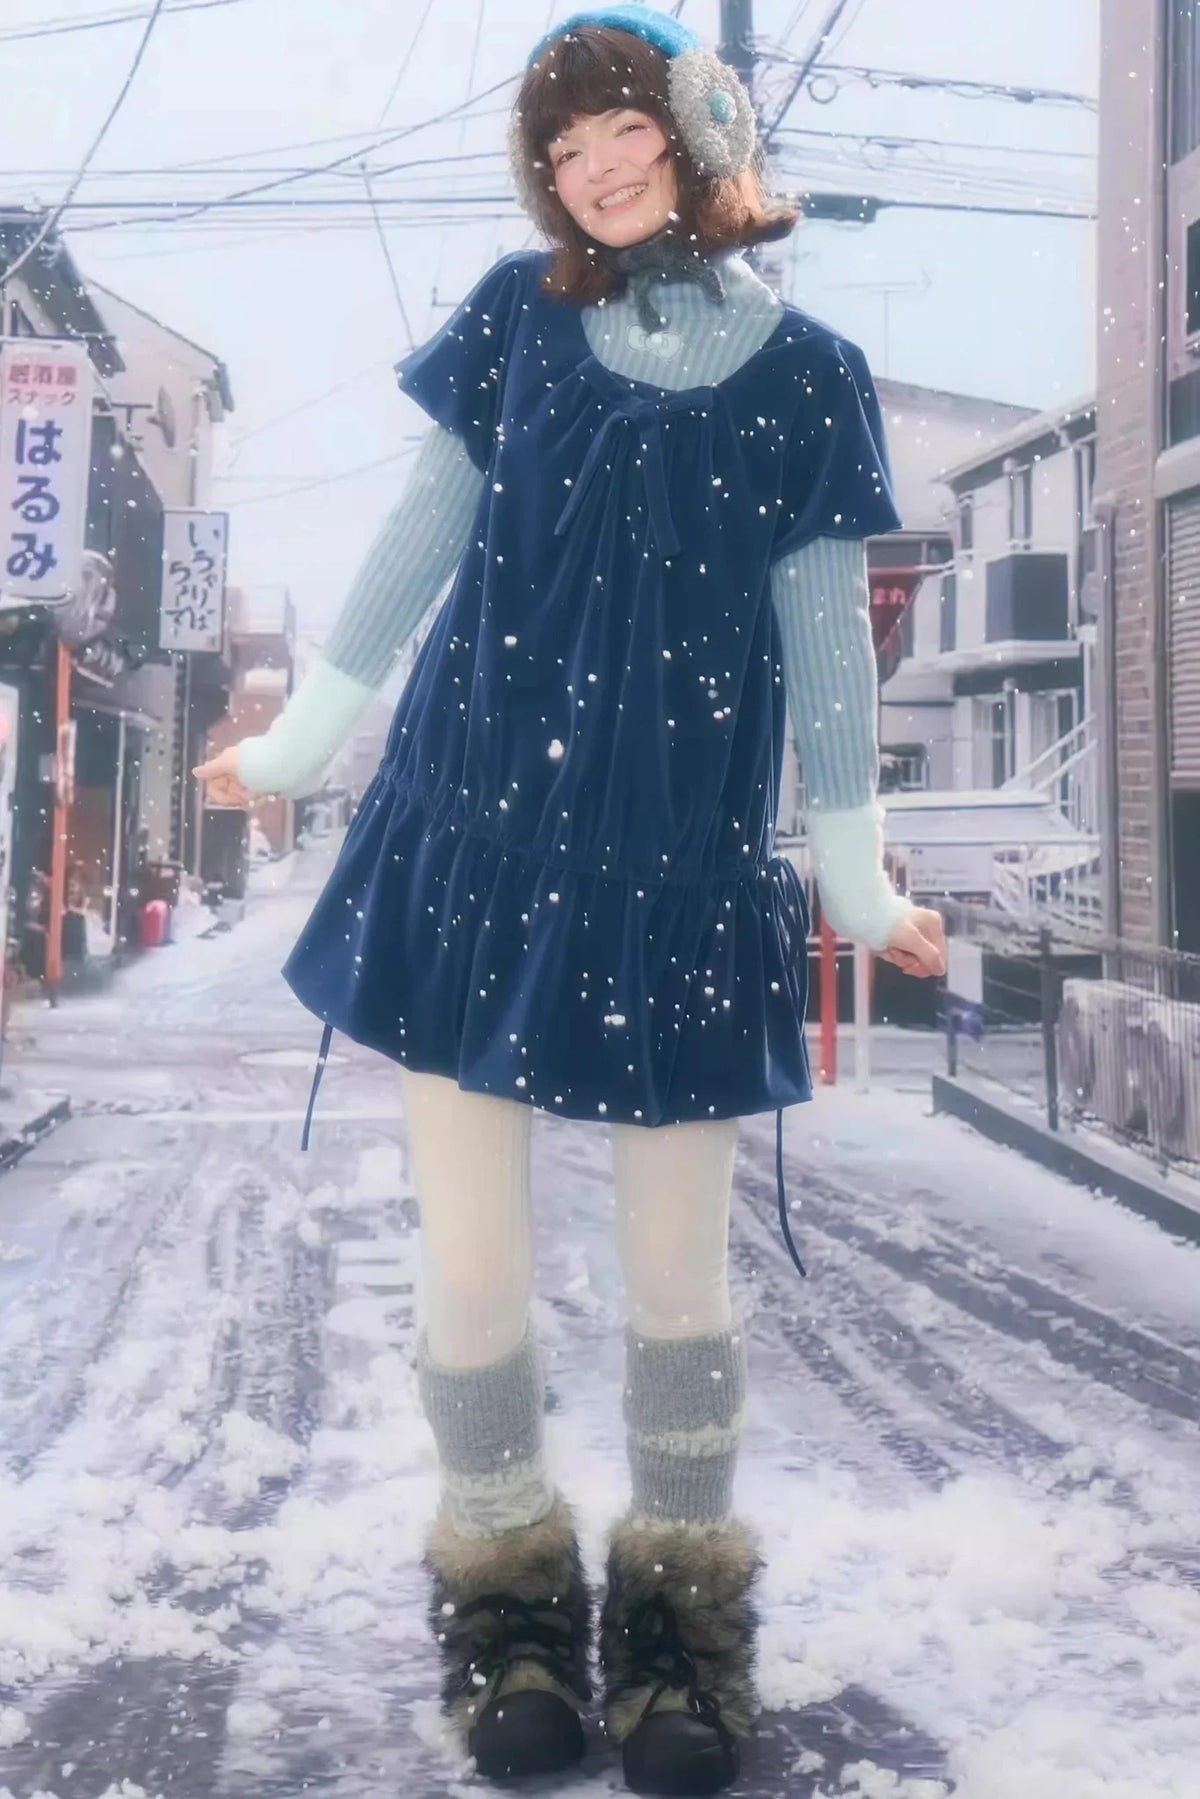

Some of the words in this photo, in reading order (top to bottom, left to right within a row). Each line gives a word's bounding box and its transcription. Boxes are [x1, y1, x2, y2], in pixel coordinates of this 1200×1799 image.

[8, 387, 76, 406] スナック
[6, 418, 63, 581] はるみ
